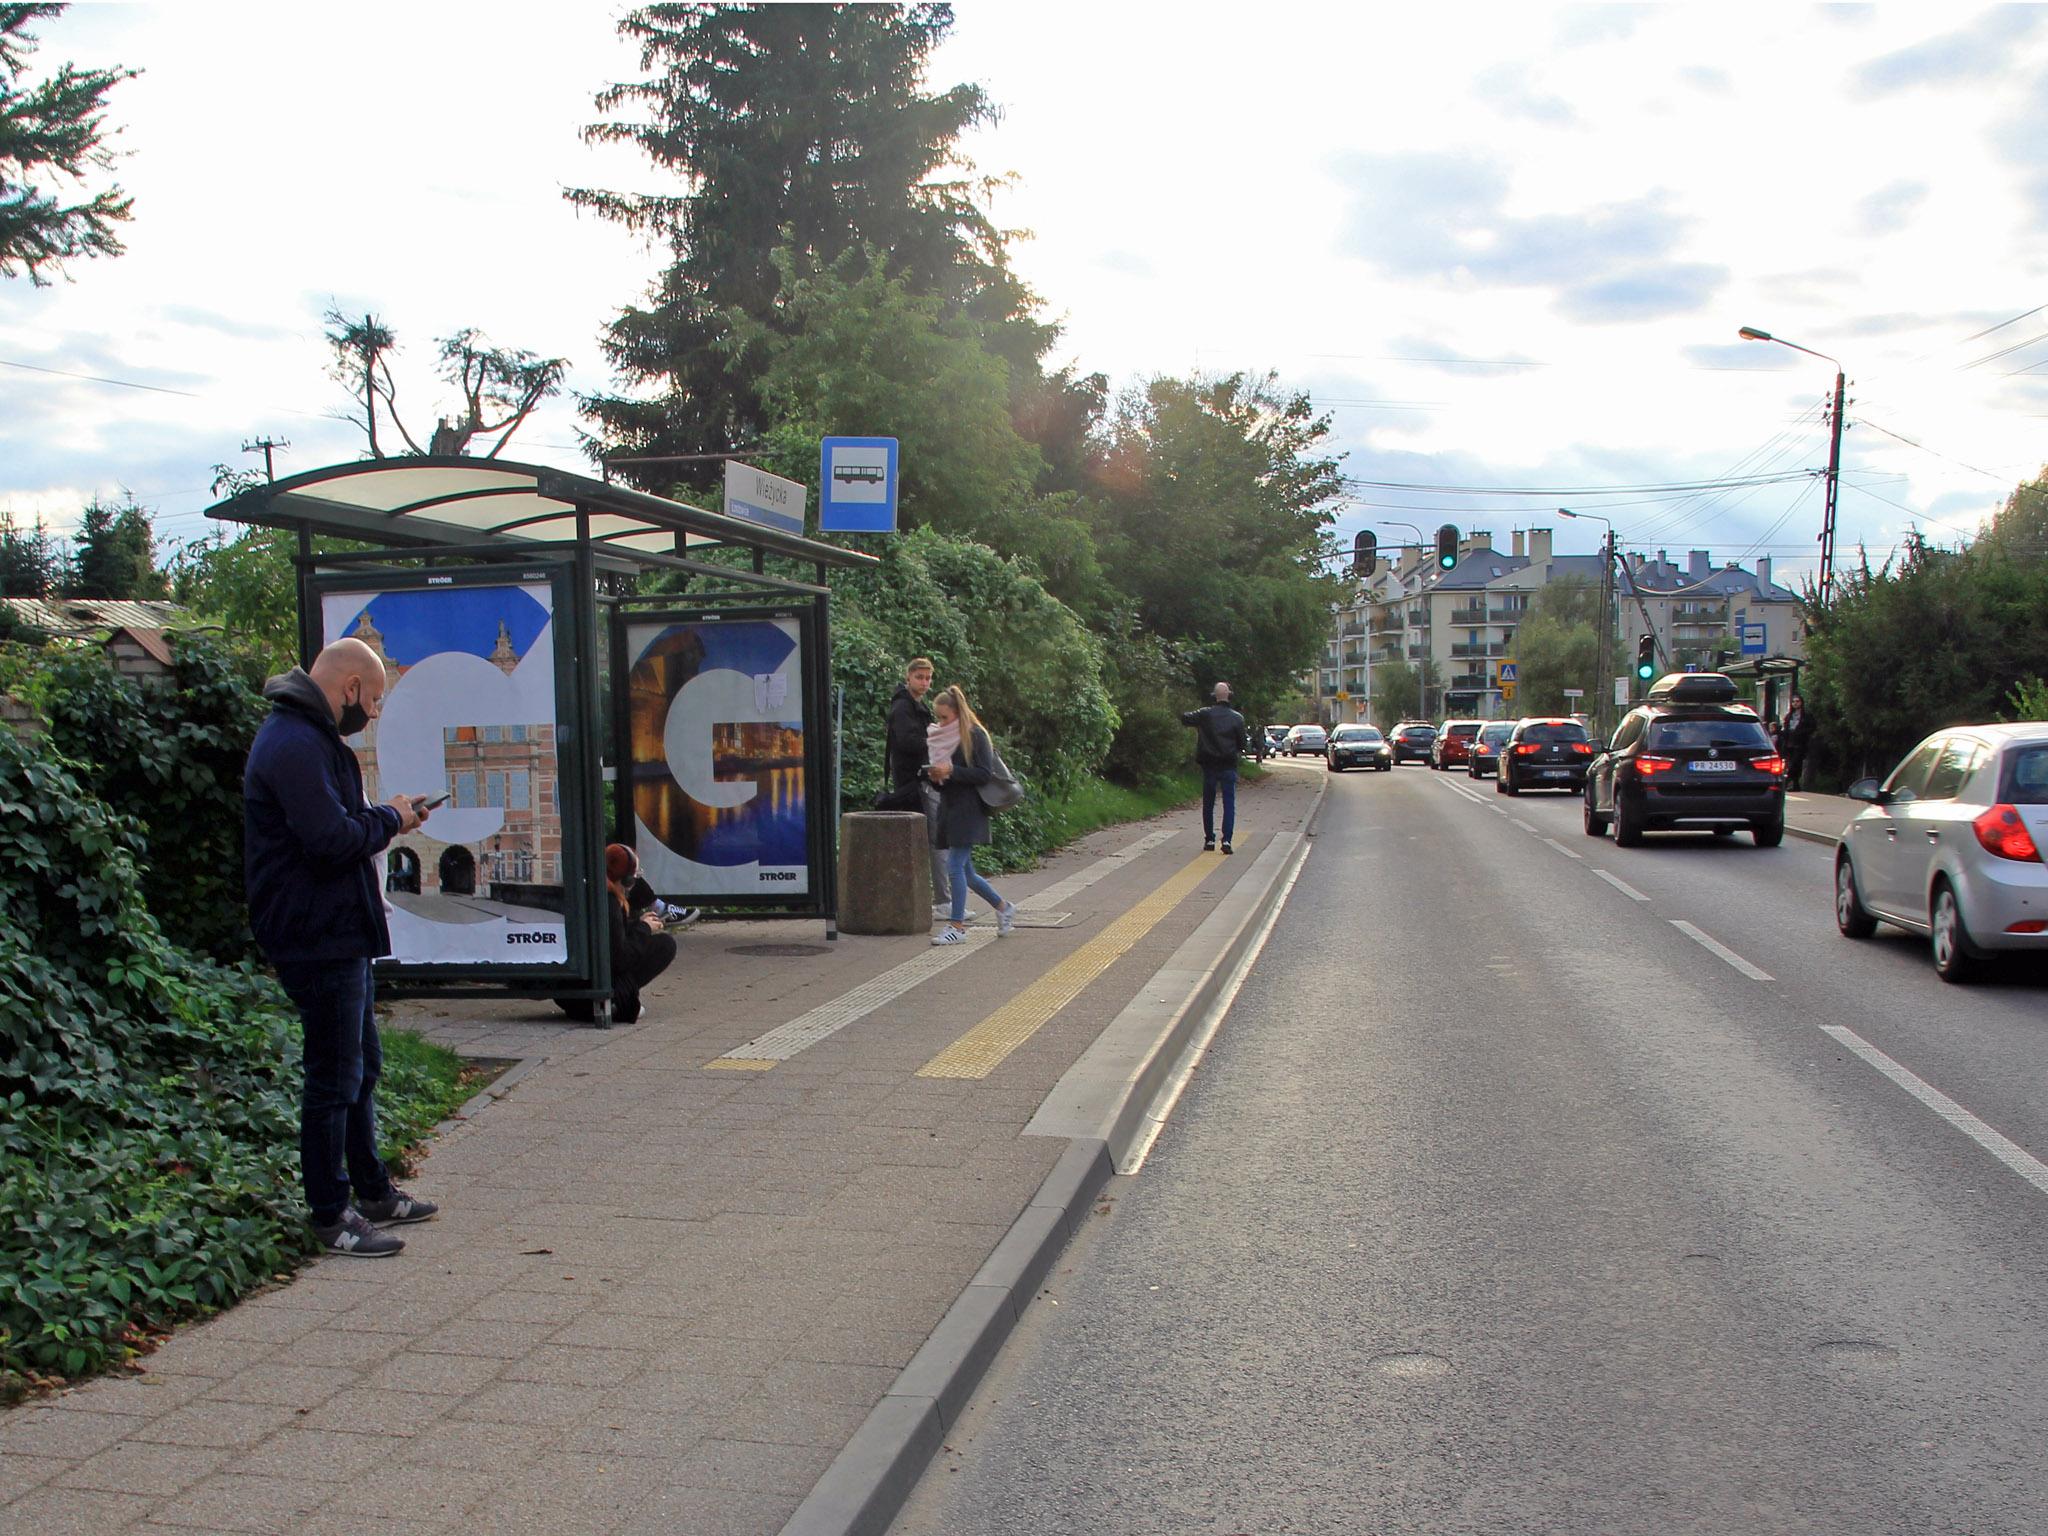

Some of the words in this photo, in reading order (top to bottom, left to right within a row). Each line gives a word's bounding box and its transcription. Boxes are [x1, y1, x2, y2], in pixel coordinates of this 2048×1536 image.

[759, 871, 797, 881] STRÖER
[506, 931, 557, 944] STRÖER
[334, 1230, 361, 1252] N
